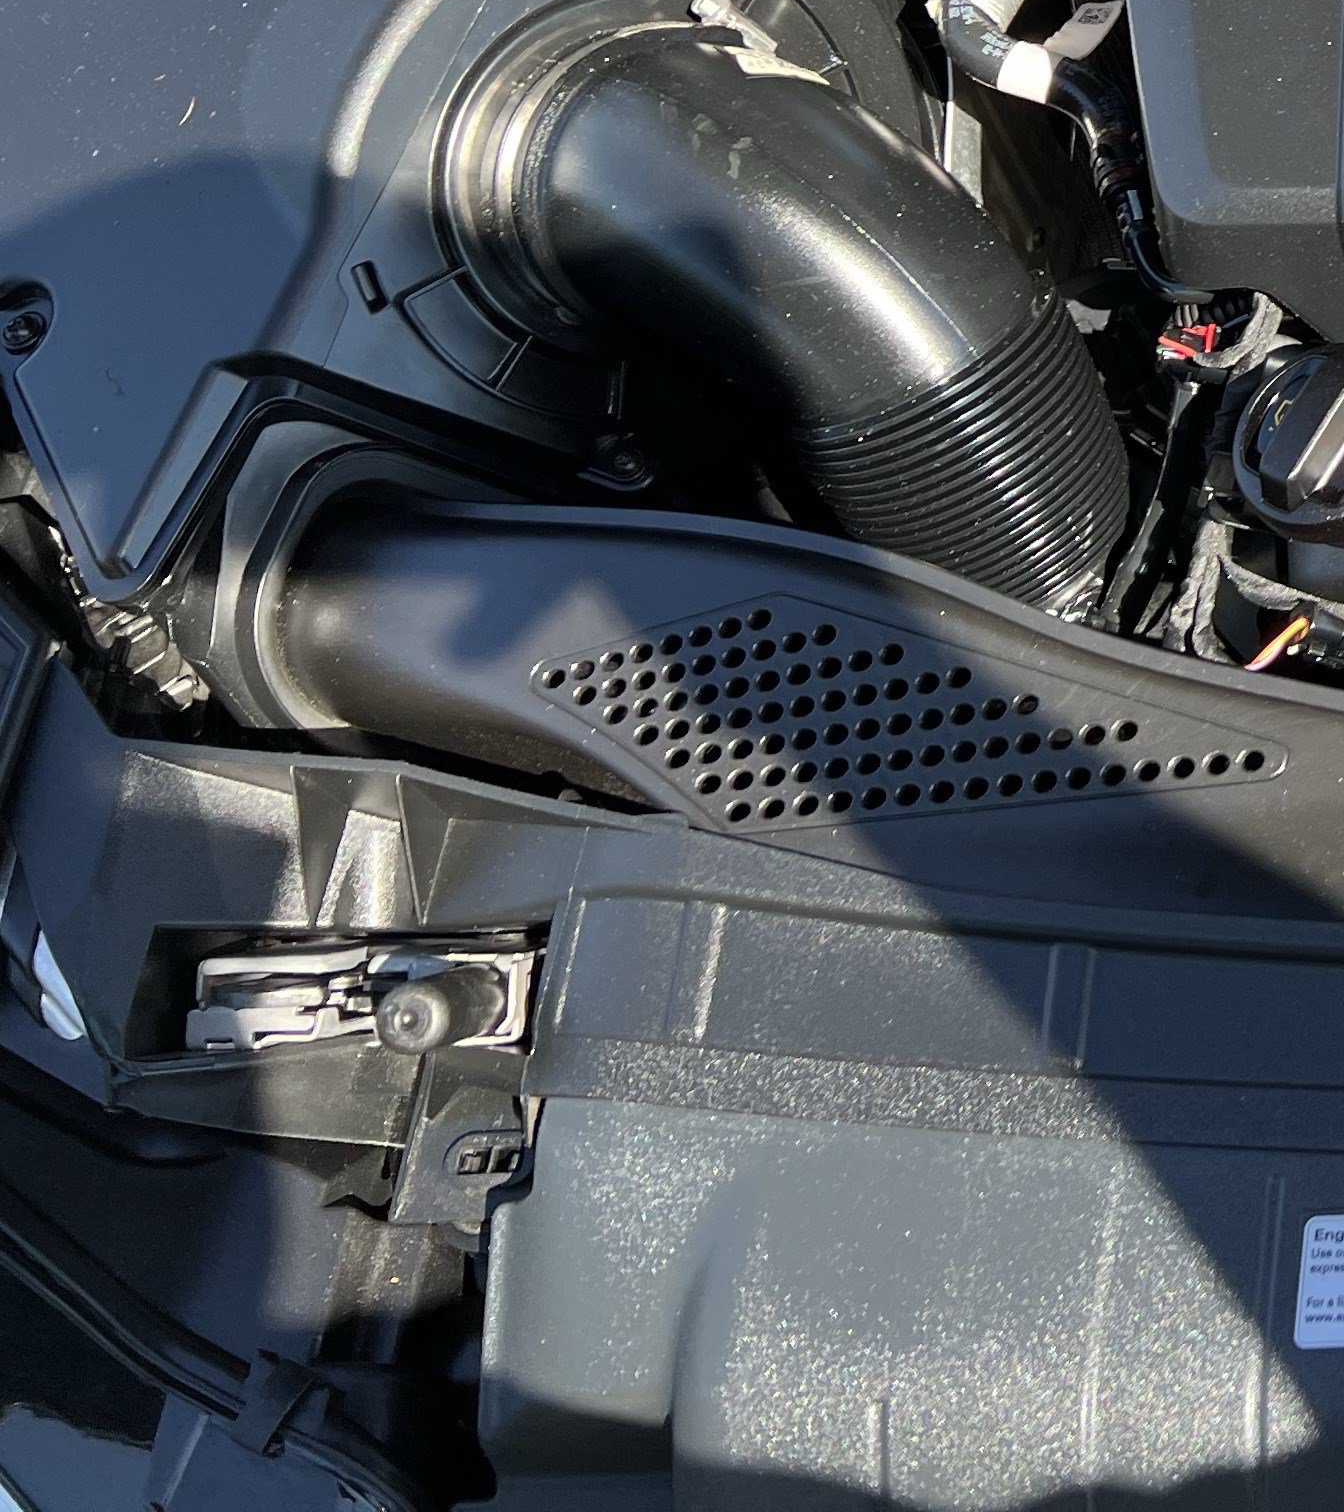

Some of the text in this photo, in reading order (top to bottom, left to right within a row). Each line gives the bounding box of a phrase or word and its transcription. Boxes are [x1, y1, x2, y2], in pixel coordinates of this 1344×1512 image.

[1311, 1247, 1332, 1258] Use
[1307, 1296, 1324, 1308] For
[1327, 1298, 1334, 1307] a
